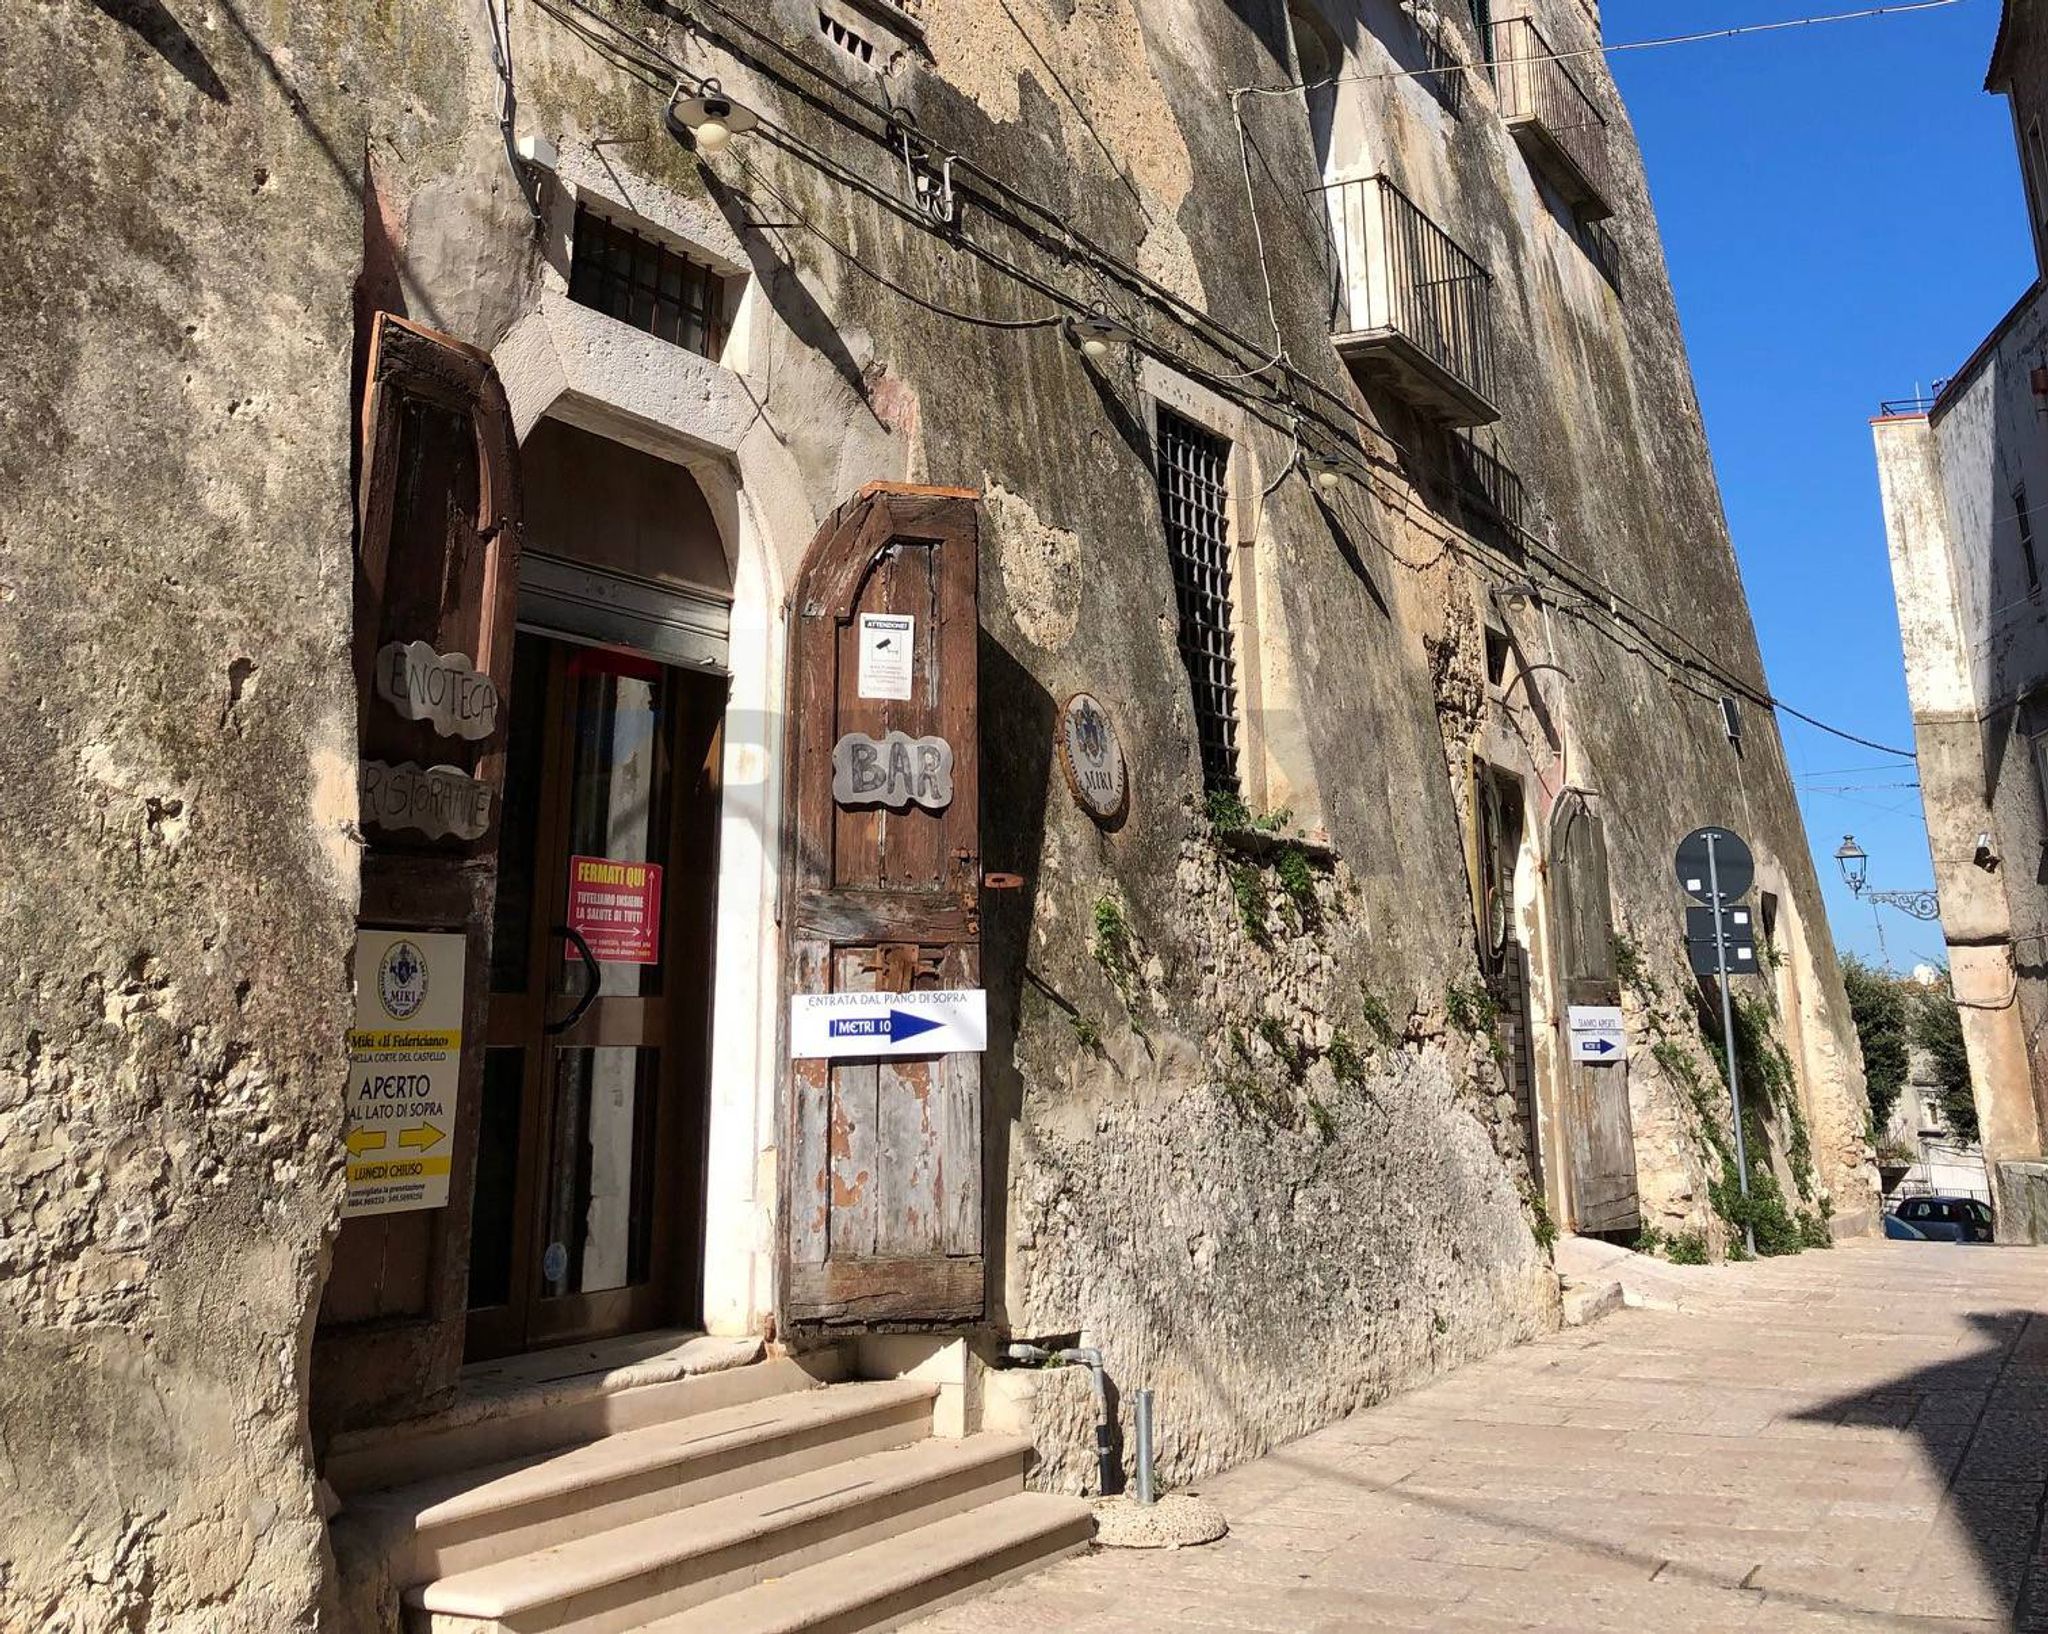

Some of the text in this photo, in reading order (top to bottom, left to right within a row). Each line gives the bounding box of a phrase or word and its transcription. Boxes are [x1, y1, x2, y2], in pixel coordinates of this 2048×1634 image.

[391, 651, 496, 725] ENOTECA
[852, 741, 942, 800] BAR
[363, 766, 488, 828] RISTORANTE
[578, 862, 646, 888] FERMATI QUI
[577, 891, 616, 906] TUTELIAMO
[576, 906, 644, 923] LA SALUTE DI TUTTI
[390, 990, 416, 1003] MIKI
[808, 992, 967, 1007] ENTRATA DAL PIANO DI SOPRA
[838, 1020, 892, 1034] METRI 10
[351, 1034, 374, 1048] Miki
[374, 1052, 398, 1063] CORTE
[400, 1052, 412, 1062] DEL
[414, 1051, 447, 1062] CASTELLO
[358, 1074, 431, 1100] APERTO
[365, 1104, 394, 1120] LATO
[397, 1103, 408, 1118] DI
[410, 1102, 443, 1118] SOPRA
[390, 1161, 423, 1177] CHIUSO
